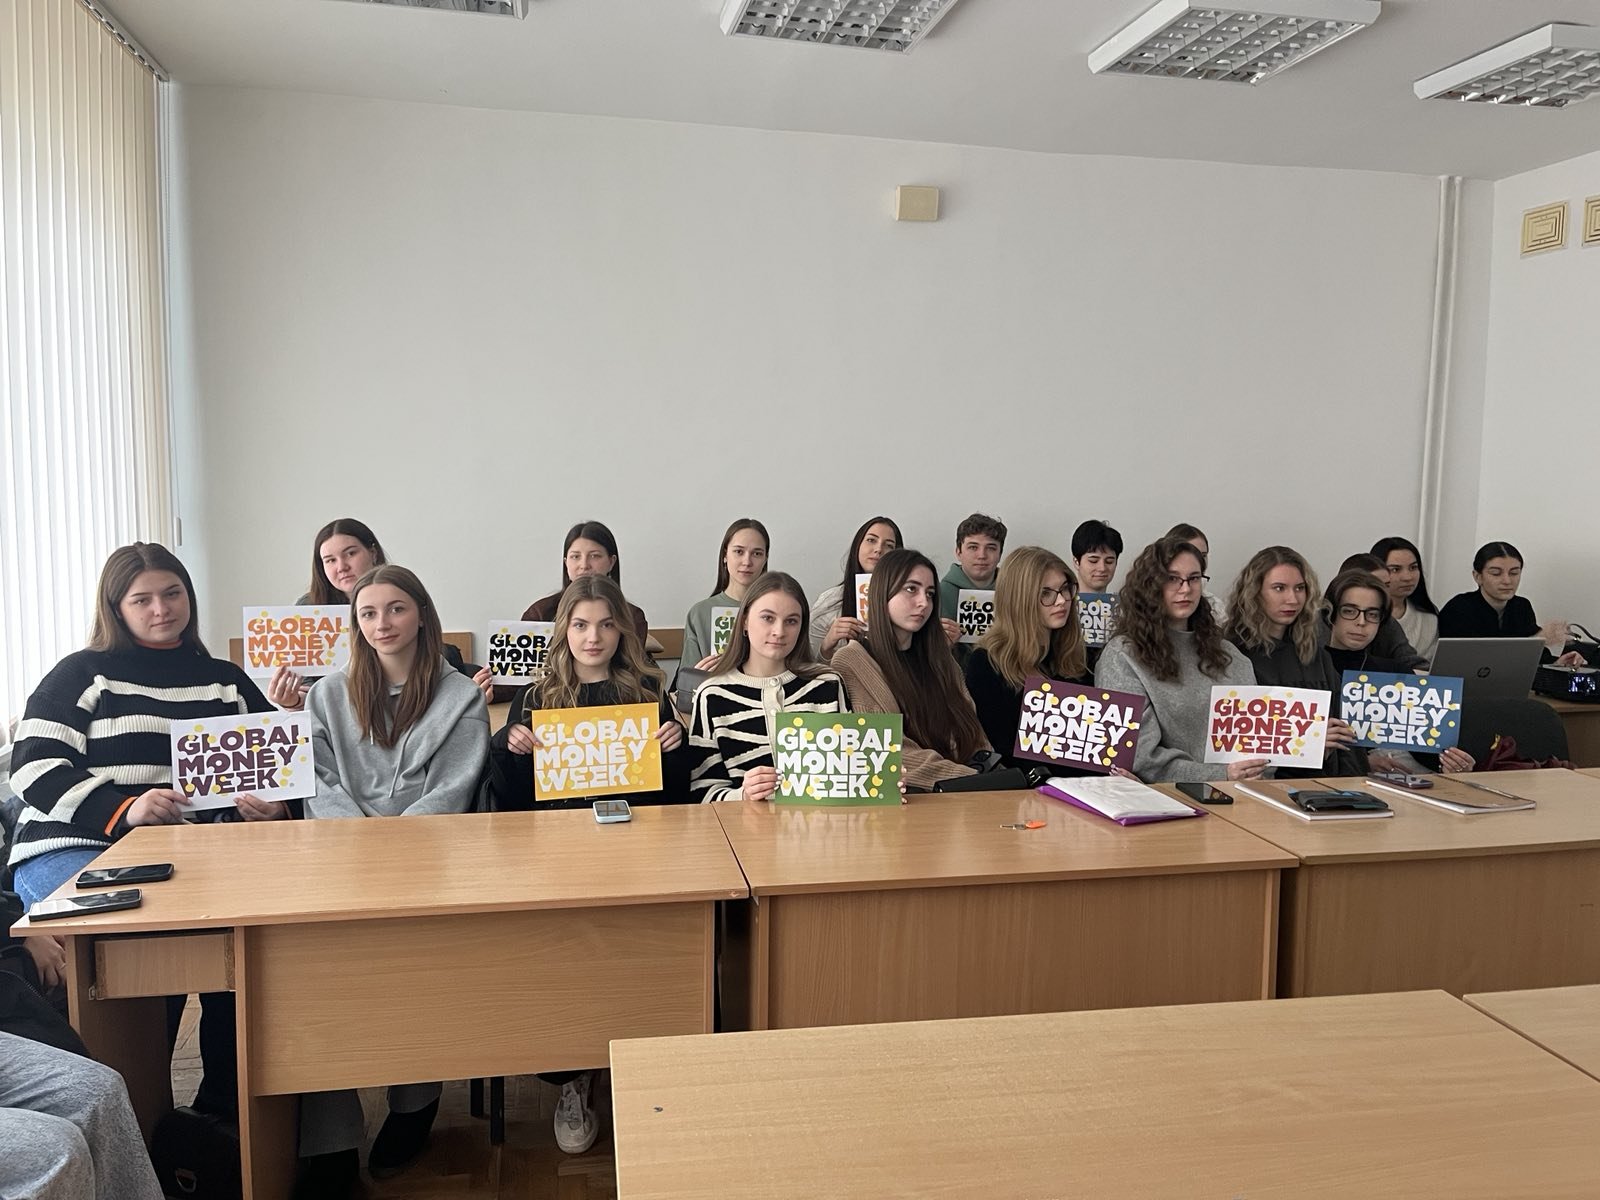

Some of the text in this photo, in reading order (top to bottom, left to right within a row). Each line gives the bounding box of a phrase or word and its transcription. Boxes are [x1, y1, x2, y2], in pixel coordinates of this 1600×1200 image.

[959, 612, 995, 625] MON
[960, 600, 995, 613] GLO
[247, 616, 349, 635] GLOBAL
[247, 633, 340, 652] MONEY
[489, 633, 554, 650] GLOB
[248, 650, 326, 668] WEEK
[489, 647, 550, 663] MONE
[488, 661, 545, 677] WEE
[1342, 681, 1461, 710] GLOBAL
[1023, 689, 1141, 730] GLOBAL
[1213, 697, 1326, 722] GLOBAL
[1340, 700, 1450, 728] MONEY
[777, 727, 902, 752] GLOBAL
[1019, 710, 1130, 747] MONEY
[1211, 716, 1314, 738] MONEY
[1340, 719, 1429, 747] WEEK
[176, 724, 310, 756] GLOBAL
[1017, 729, 1107, 766] WEEK
[1210, 734, 1293, 756] WEEK
[177, 744, 299, 778] MONEY
[535, 739, 649, 770] MONEY
[777, 750, 891, 775] MONEY
[178, 767, 281, 798] WEEK
[535, 763, 631, 793] WEEK
[778, 773, 871, 798] WEEK
